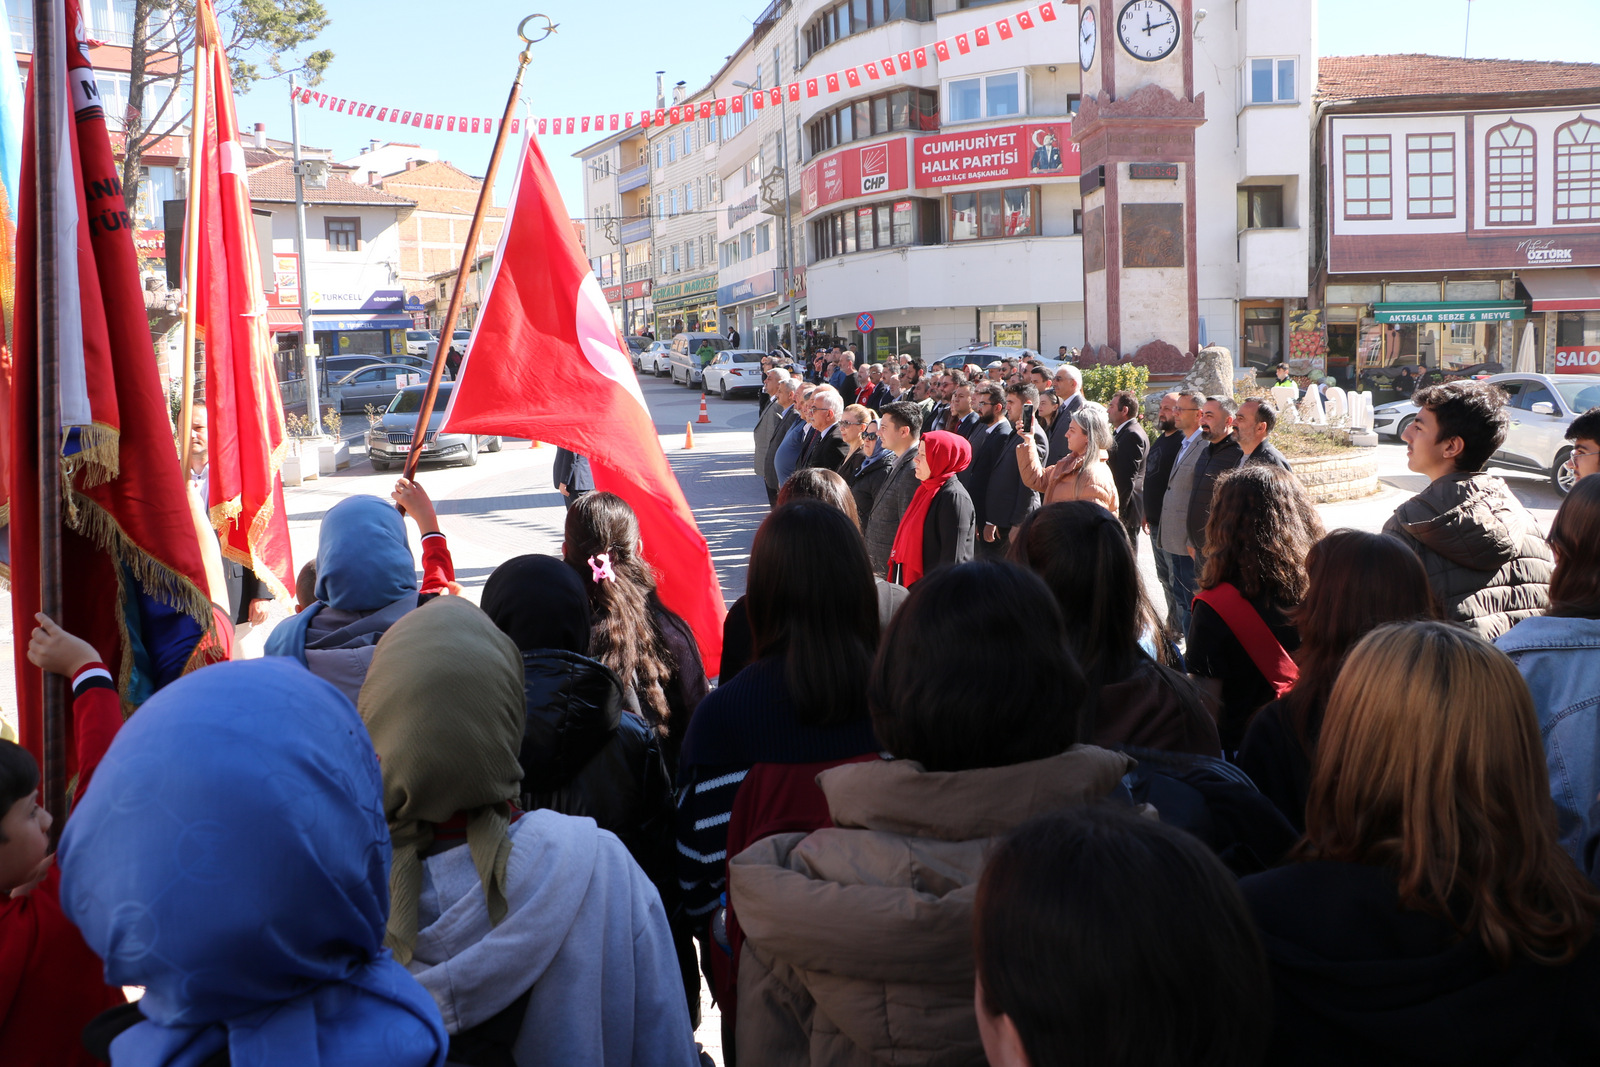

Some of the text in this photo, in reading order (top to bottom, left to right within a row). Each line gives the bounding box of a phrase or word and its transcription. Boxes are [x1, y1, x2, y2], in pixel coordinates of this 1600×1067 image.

[1133, 3, 1141, 11] 11
[1144, 0, 1153, 9] 12
[1158, 4, 1162, 12] 1
[1125, 12, 1133, 20] 10
[1121, 24, 1127, 32] 9
[1169, 26, 1175, 34] 3
[1125, 37, 1130, 45] 8
[1166, 37, 1172, 45] 4
[1146, 50, 1151, 58] 6
[1158, 47, 1163, 55] 5
[922, 133, 1017, 155] CUMHURİYET
[921, 148, 1019, 174] HALK PARTİSİ
[932, 168, 1009, 183] ILGAZ İLÇE BAŞKANLIĞI
[863, 176, 886, 191] CHP
[1527, 248, 1573, 260] ÖZTÜRK
[684, 277, 715, 293] MARKET
[322, 293, 363, 301] TURKCELL
[1389, 313, 1433, 322] AKTAŞLAR
[1438, 313, 1465, 321] SEBZE
[1481, 311, 1511, 320] MEYVE
[1556, 350, 1600, 367] SALO
